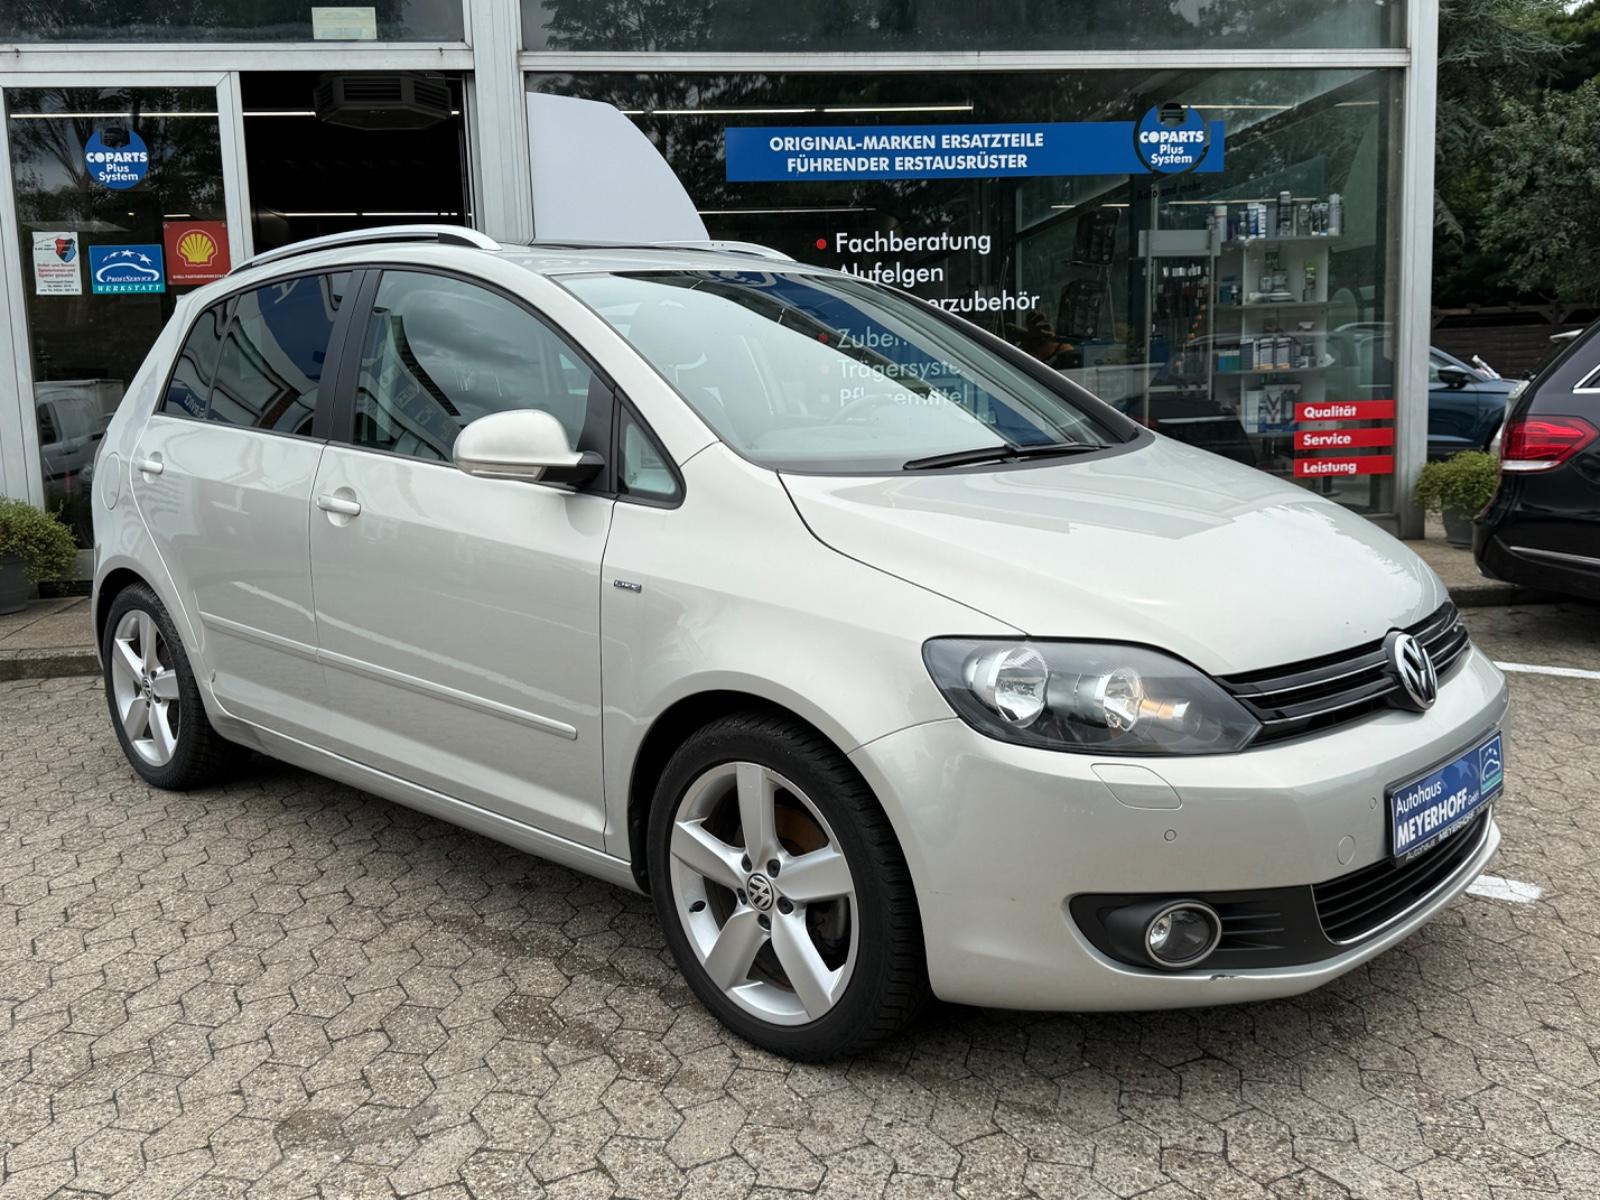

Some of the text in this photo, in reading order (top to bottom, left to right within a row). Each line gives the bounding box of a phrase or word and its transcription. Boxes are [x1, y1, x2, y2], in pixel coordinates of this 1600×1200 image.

[769, 132, 1044, 152] ORIGINAL-MARKEN ERSATZTEILE
[1140, 130, 1204, 143] COPARTS
[1159, 144, 1184, 154] Plus
[86, 152, 148, 163] COPARTS
[787, 152, 1028, 173] FÜHRENDER ERSTAUSRÜSTER
[1151, 153, 1192, 166] System
[106, 163, 130, 173] Plus
[98, 171, 139, 183] System
[836, 230, 991, 254] Fachberatung
[97, 284, 160, 292] WERKSTATT
[1304, 405, 1357, 418] Qualität
[1303, 433, 1352, 446] Service
[1303, 462, 1357, 474] Leistung
[1396, 781, 1442, 817] Autohaus
[1397, 787, 1468, 849] MEYERHOFF
